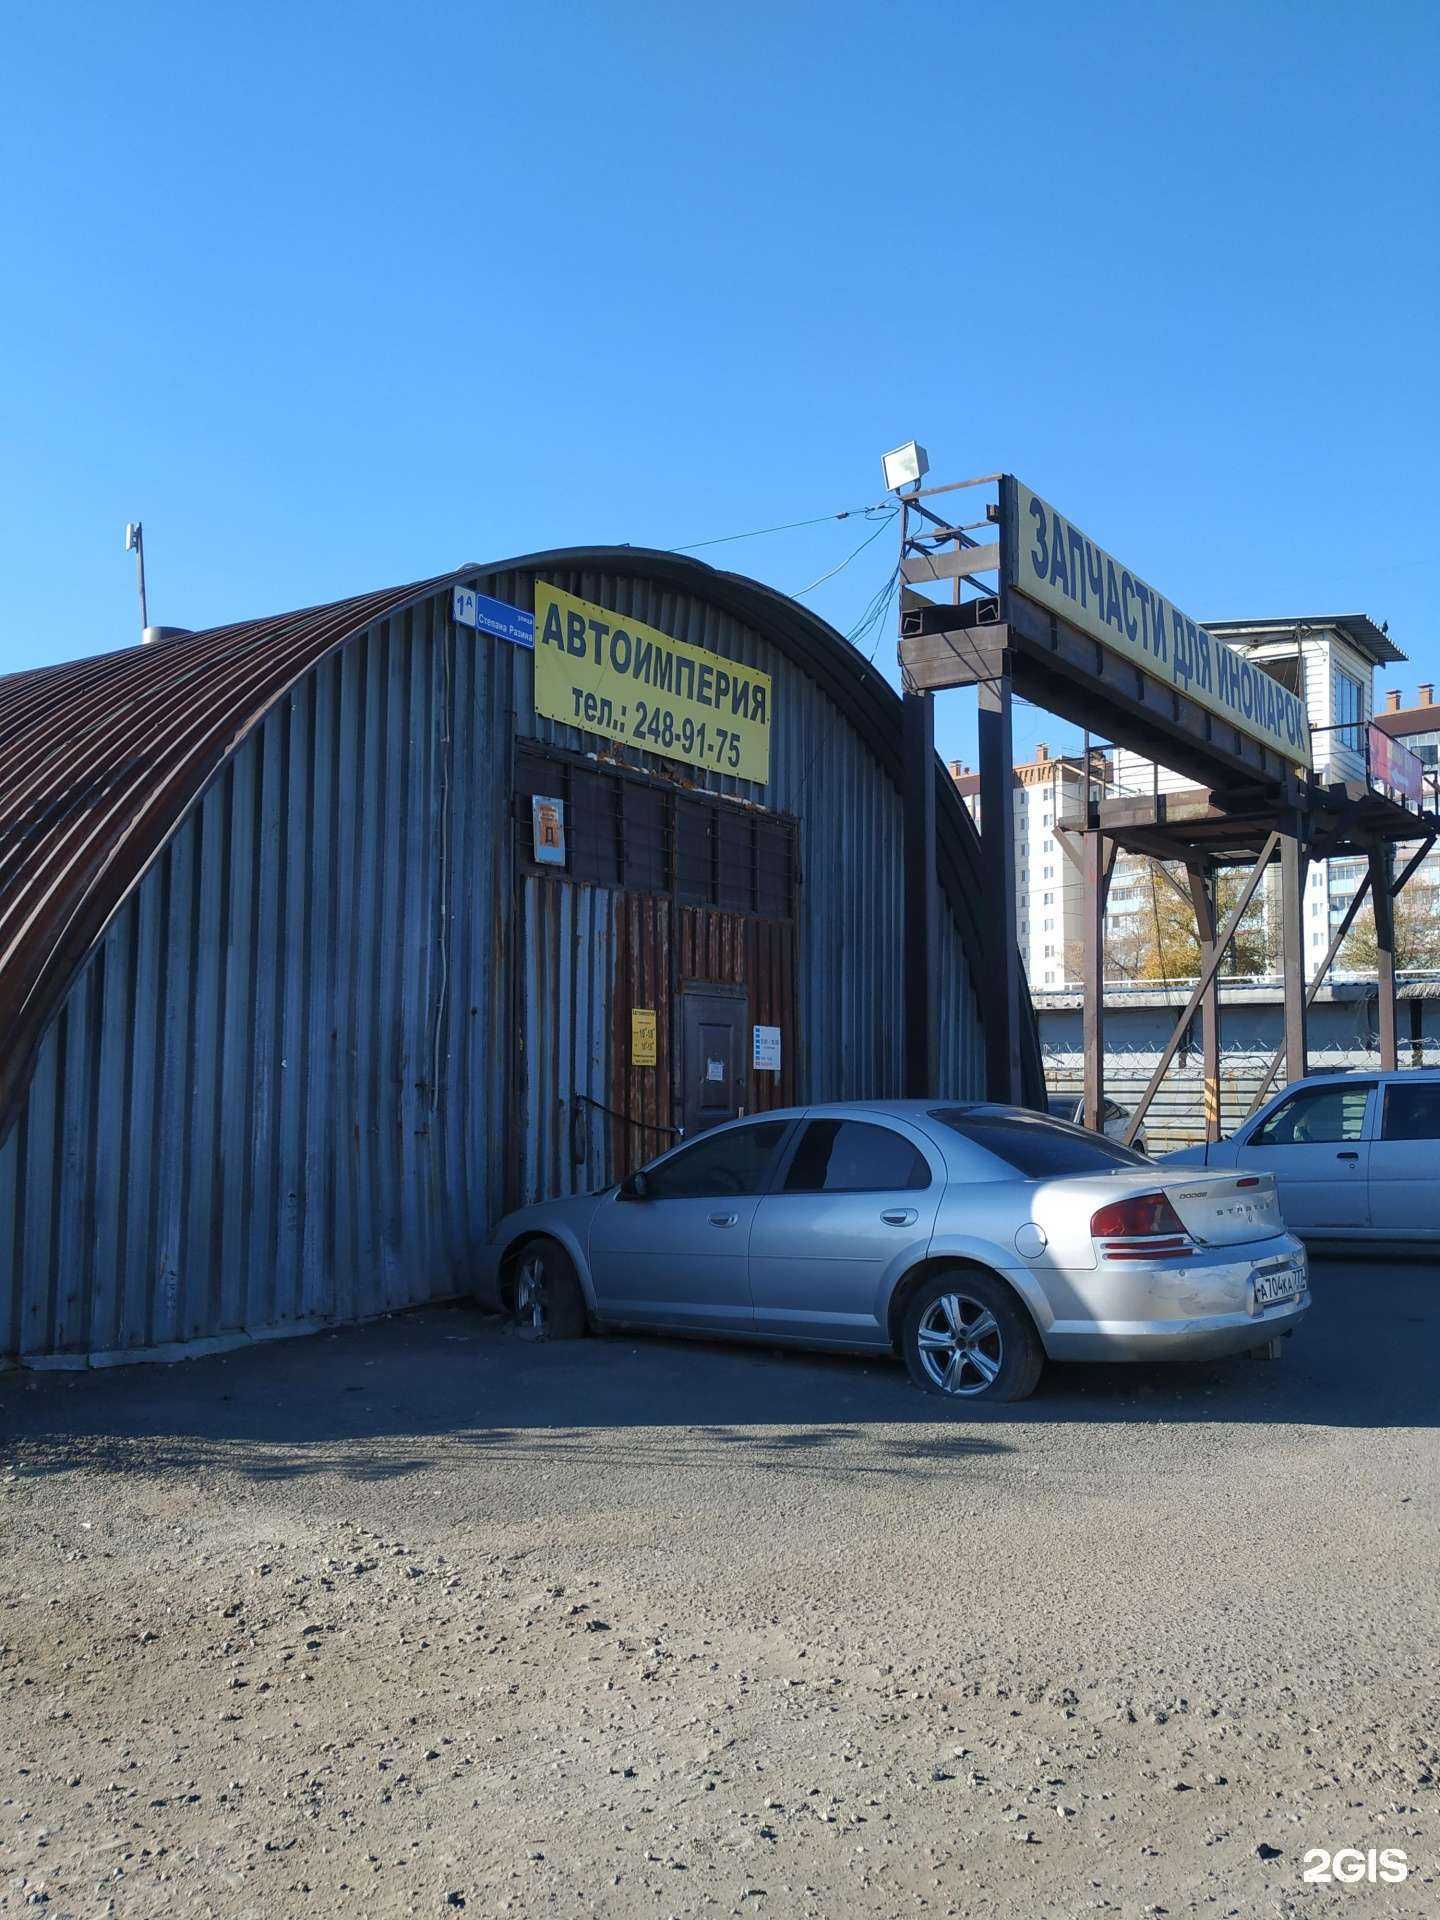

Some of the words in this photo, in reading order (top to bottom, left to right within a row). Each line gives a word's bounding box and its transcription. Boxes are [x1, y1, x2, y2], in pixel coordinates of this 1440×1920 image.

[479, 613, 508, 633] Степана
[509, 625, 533, 642] Разина
[541, 602, 766, 725] АВТОИМПЕРИЯ
[1029, 497, 1167, 664] ЗАПЧАСТИ
[1172, 608, 1213, 694] ДЛЯ
[1216, 642, 1306, 753] ИНОМАРОК
[572, 687, 627, 733] тел.:
[632, 701, 742, 768] 248-91-75
